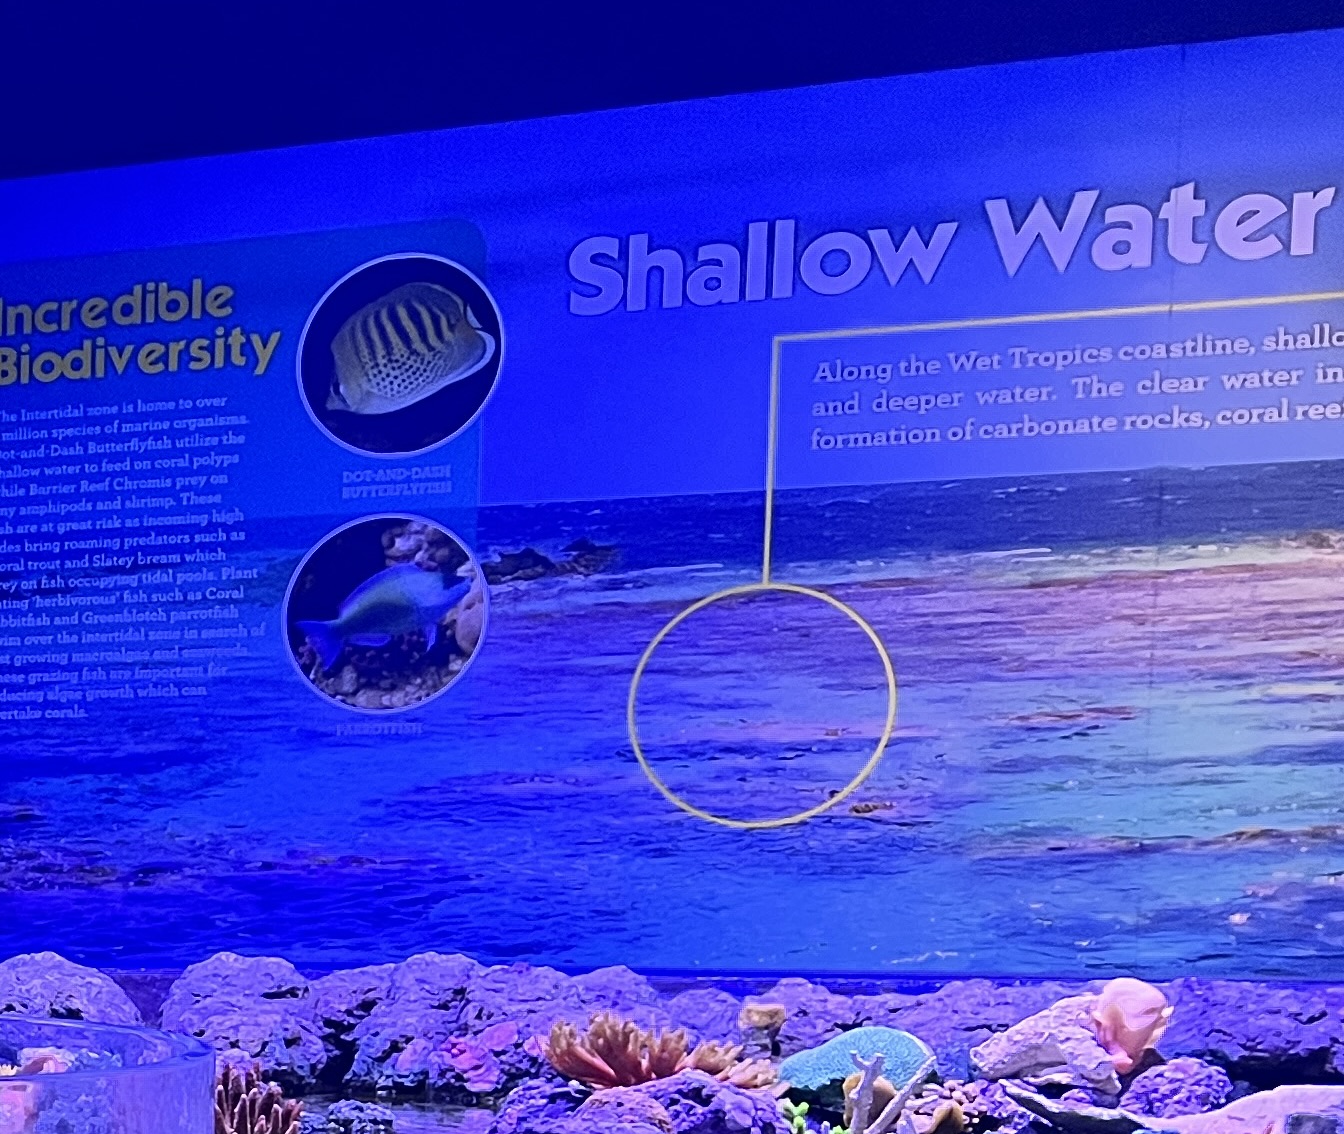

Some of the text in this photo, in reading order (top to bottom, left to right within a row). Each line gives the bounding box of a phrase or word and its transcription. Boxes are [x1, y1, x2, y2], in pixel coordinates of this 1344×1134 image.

[569, 182, 1335, 315] Shallow Water
[813, 360, 894, 384] Along
[898, 354, 941, 376] the
[947, 351, 1001, 372] Wet
[1008, 345, 1113, 371] Tropics
[1118, 333, 1255, 360] coastline,
[812, 392, 860, 416] and
[872, 390, 964, 414] deeper
[975, 386, 1057, 404] water.
[1071, 375, 1124, 398] The
[1137, 371, 1209, 394] clear
[1221, 370, 1304, 389] water
[812, 398, 1344, 449] formation of carbonate rocks, coral ree
